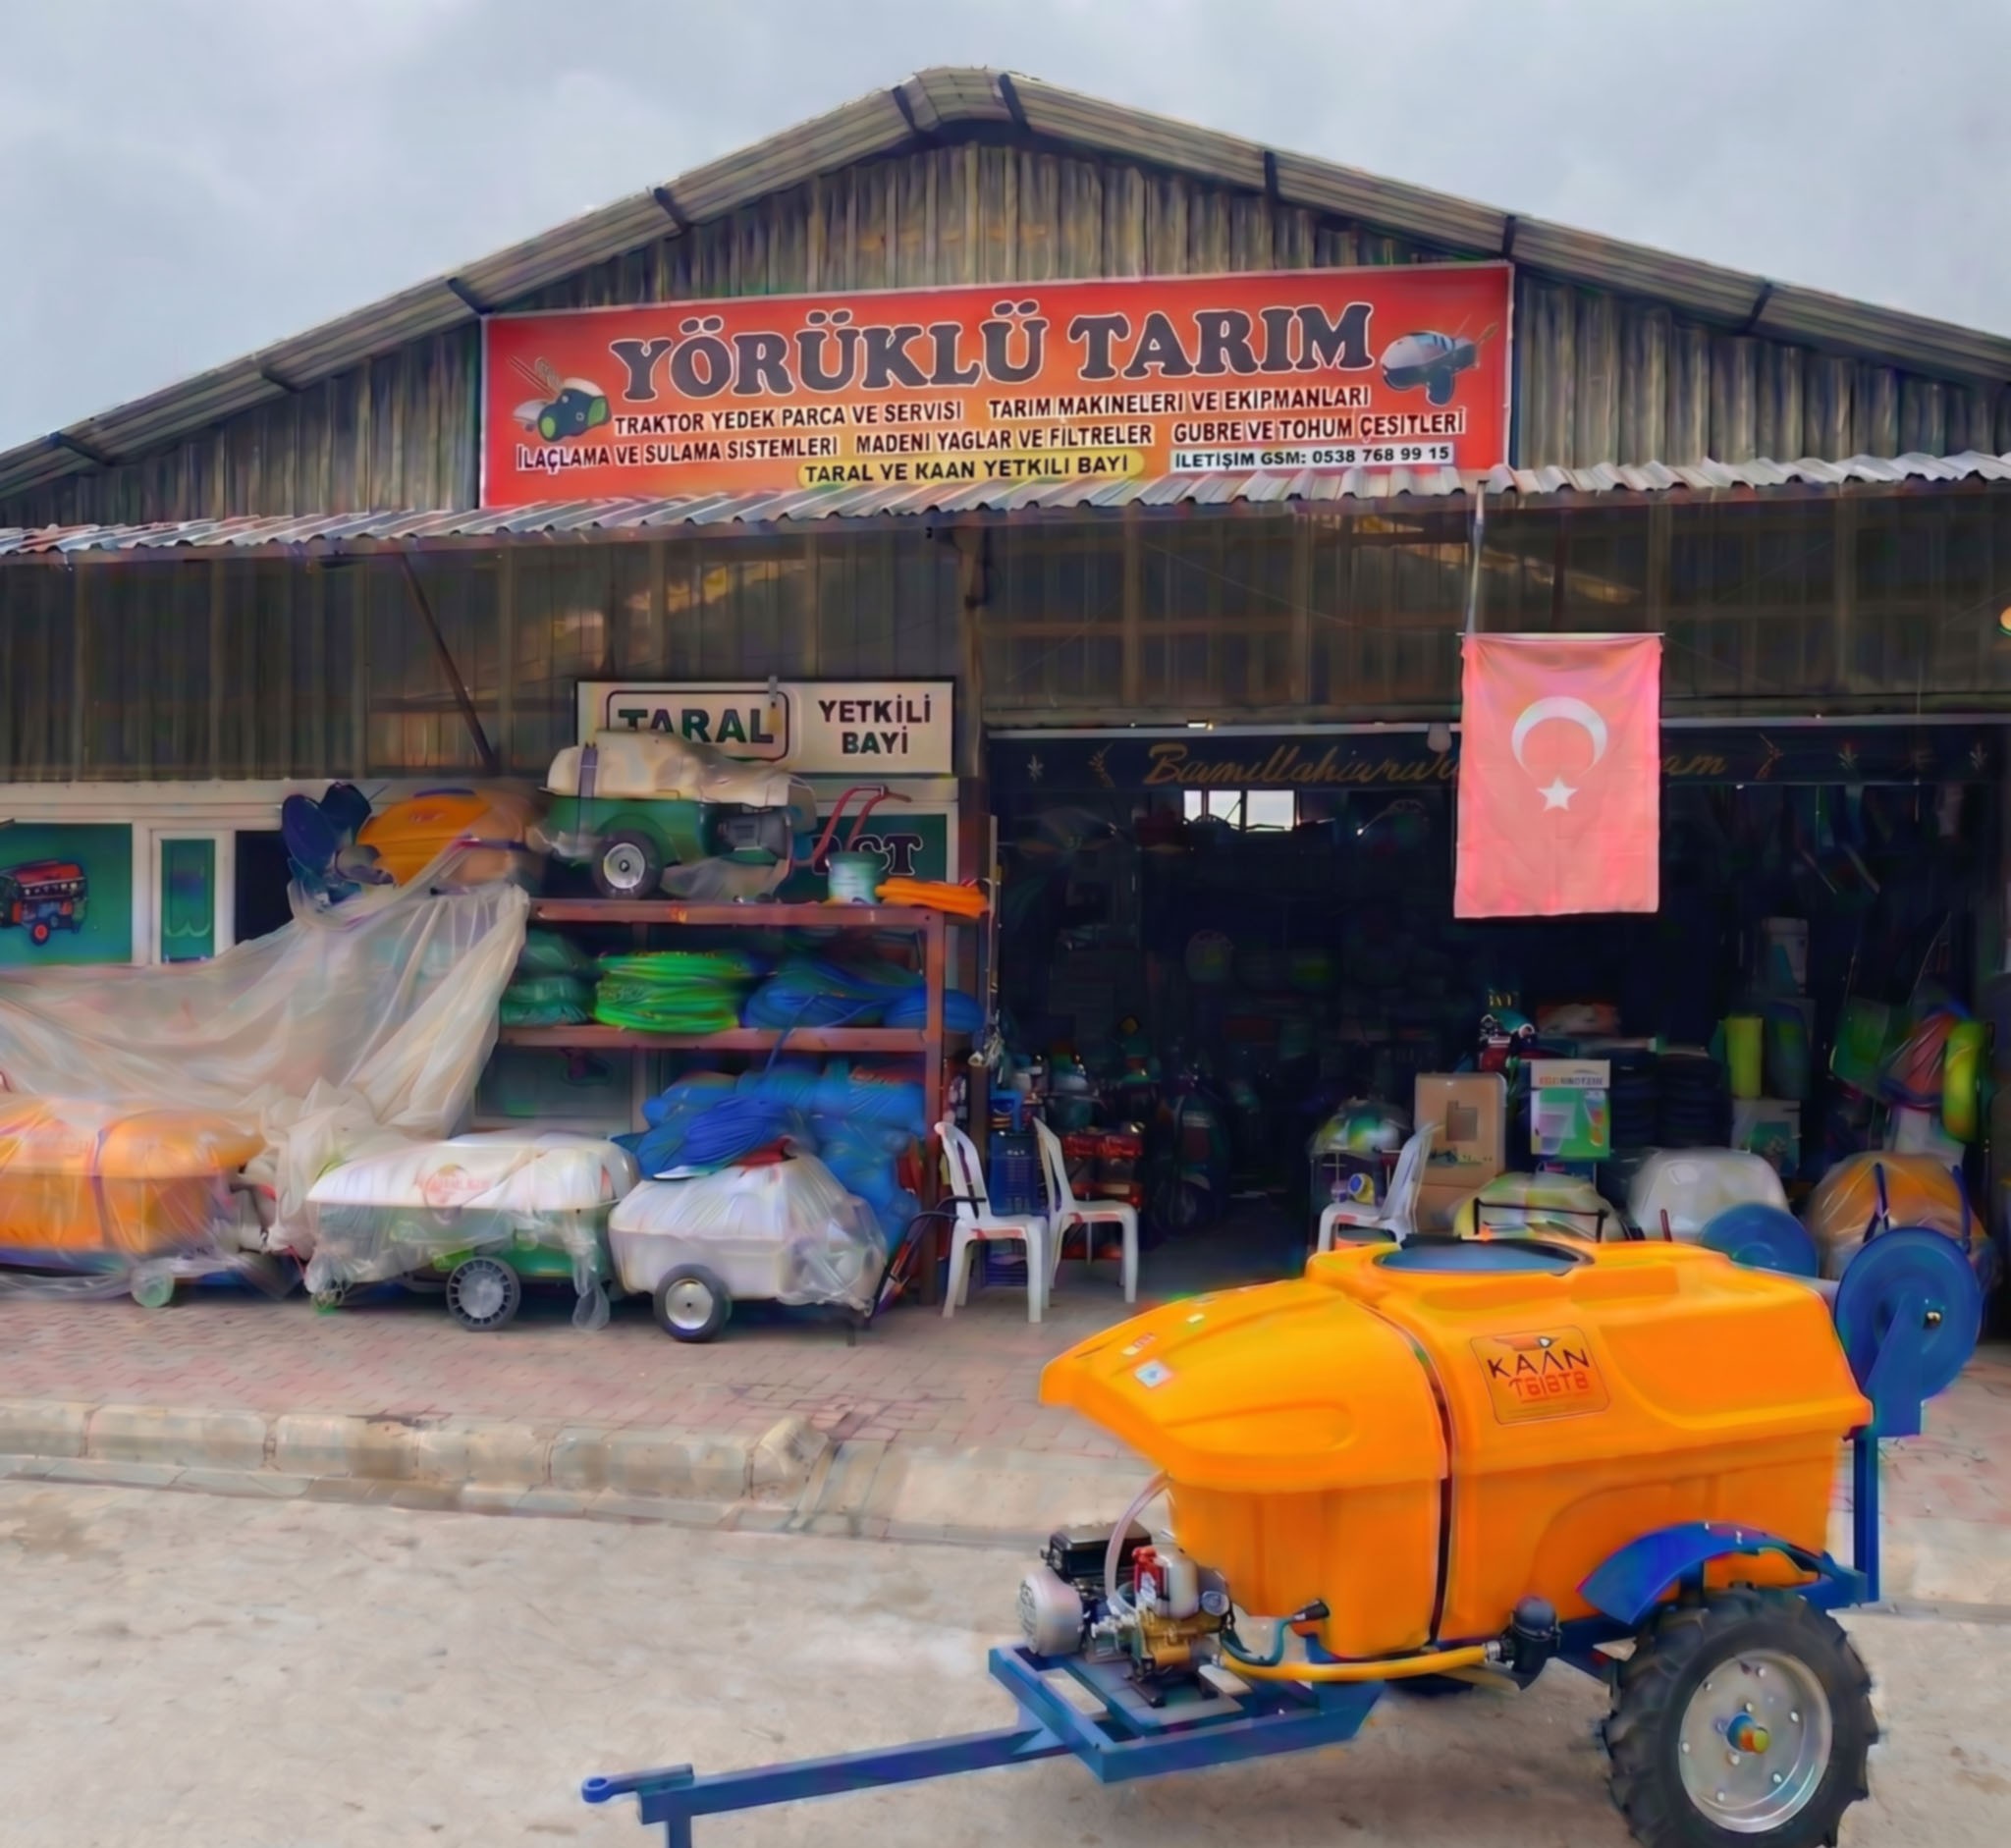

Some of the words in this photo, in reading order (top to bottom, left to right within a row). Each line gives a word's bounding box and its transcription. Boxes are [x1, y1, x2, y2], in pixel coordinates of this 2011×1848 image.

[610, 299, 1049, 403] YÖRÜKLÜ
[1067, 301, 1376, 381] TARIM
[990, 398, 1051, 418] TARIM
[1192, 392, 1217, 410] VE
[616, 413, 704, 434] TRAKTOR
[712, 408, 775, 430] YEDEK
[852, 405, 878, 423] VE
[1248, 421, 1274, 440] VE
[1279, 417, 1352, 439] TOHUM
[1019, 429, 1043, 448] VE
[616, 446, 638, 463] VE
[645, 442, 722, 463] SULAMA
[1261, 451, 1306, 464] GSM:
[1312, 449, 1356, 463] 0538
[1362, 448, 1394, 462] 768
[1400, 447, 1422, 461] 99
[1429, 446, 1449, 460] 15
[805, 464, 873, 482] TARAL
[880, 462, 908, 480] VE
[915, 461, 975, 480] KAAN
[818, 693, 932, 724] YETKİLİ
[618, 708, 775, 744] TARAL
[842, 725, 908, 754] BAYİ
